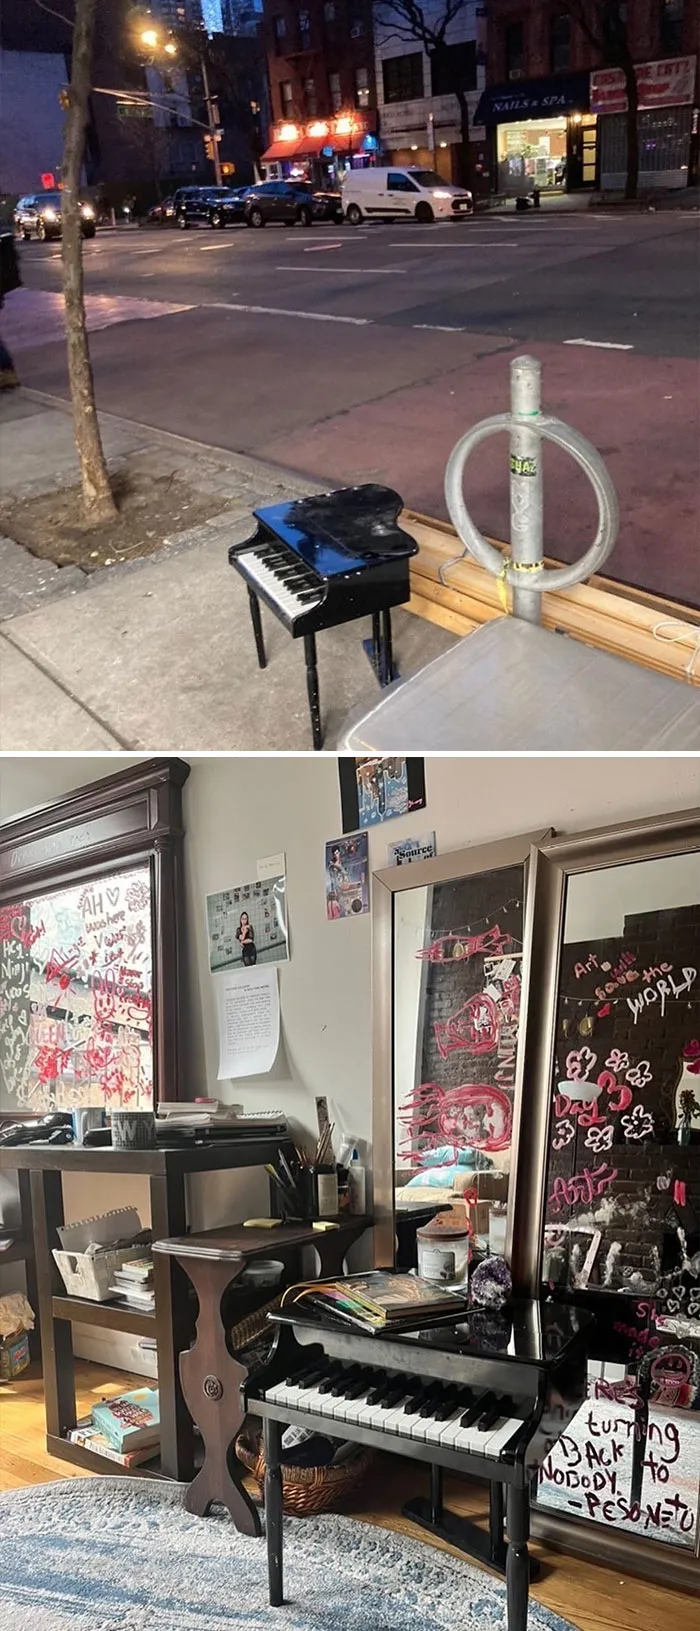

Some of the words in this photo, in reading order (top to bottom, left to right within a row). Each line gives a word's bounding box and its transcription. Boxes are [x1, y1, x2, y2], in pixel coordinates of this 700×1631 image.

[492, 99, 530, 113] NAILS
[541, 95, 566, 107] SPA
[82, 893, 103, 918] AH
[574, 953, 599, 979] Art
[642, 962, 673, 983] the
[626, 967, 697, 1025] WORLD
[554, 1094, 608, 1127] Day
[584, 1410, 681, 1464] turning
[640, 1450, 670, 1484] to
